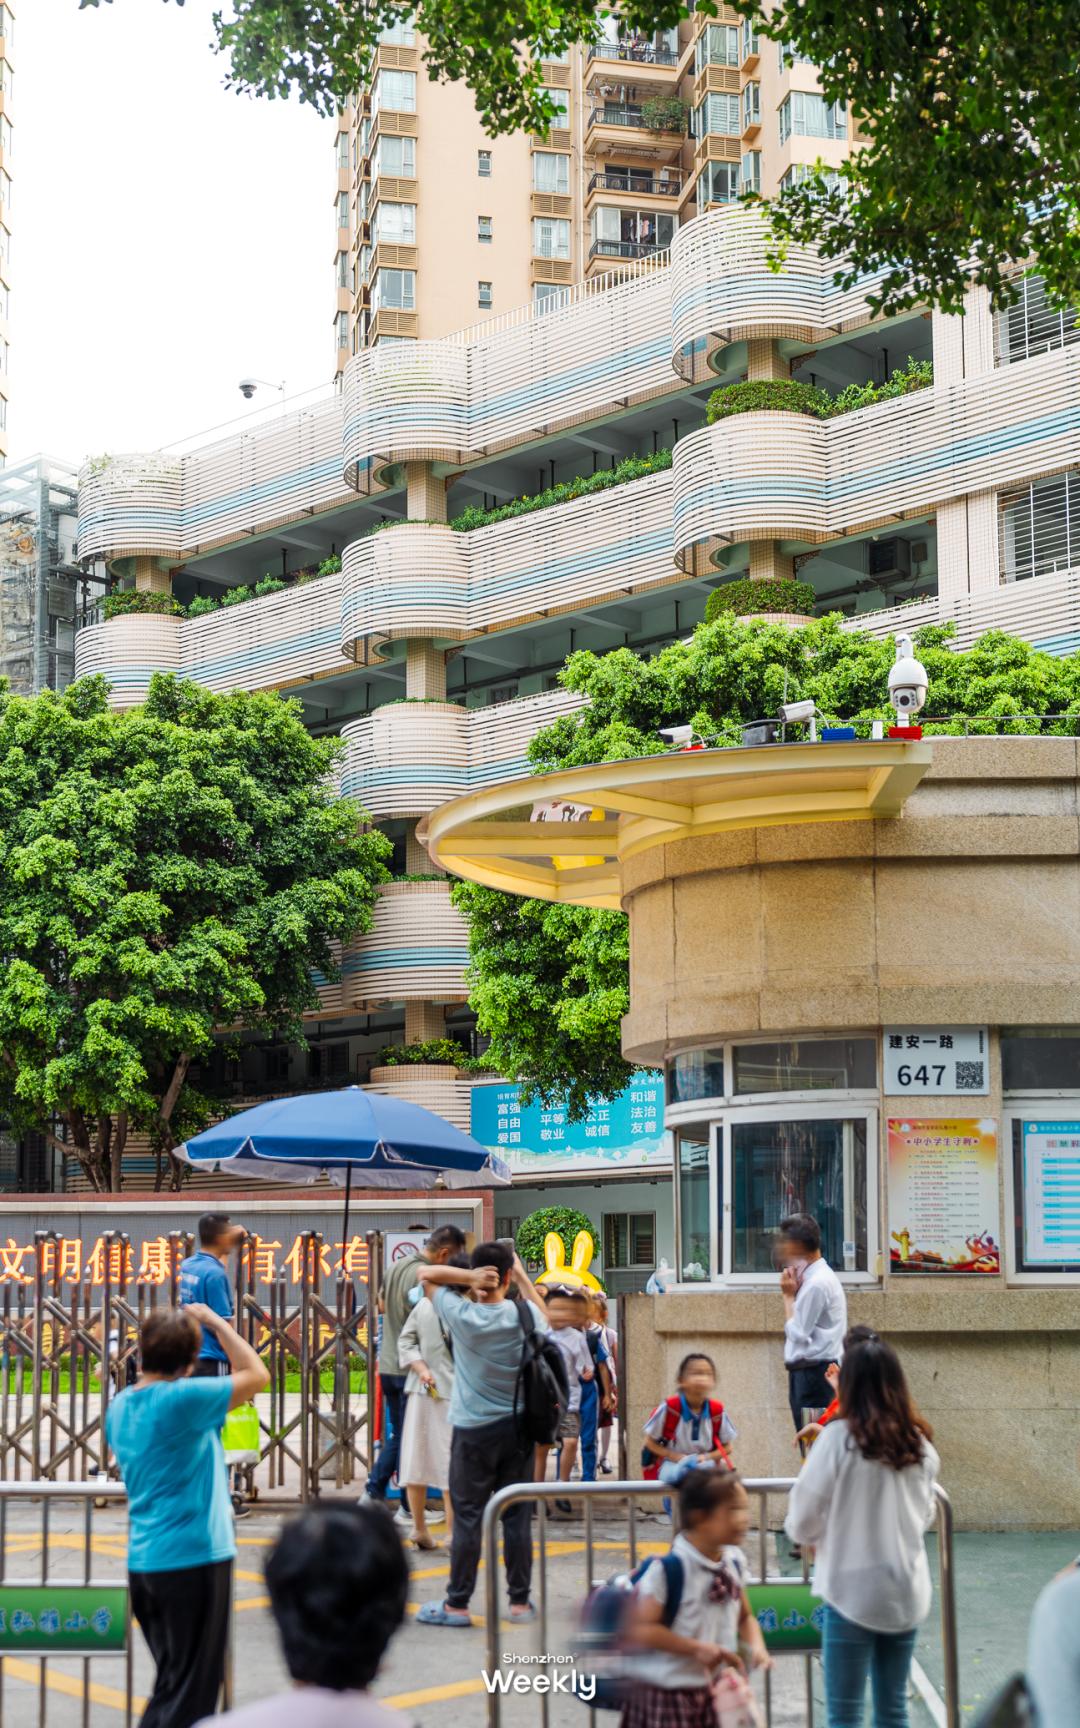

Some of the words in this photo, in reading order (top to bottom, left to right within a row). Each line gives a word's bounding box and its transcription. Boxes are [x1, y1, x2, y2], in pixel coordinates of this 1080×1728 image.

[889, 1034, 954, 1049] 建安一路
[897, 1065, 946, 1086] 647
[498, 1103, 520, 1115] 富强
[631, 1090, 657, 1103] 和谐
[498, 1117, 520, 1129] 自由
[541, 1113, 565, 1126] 平等
[586, 1109, 610, 1122] 公正
[631, 1106, 657, 1119] 法治
[498, 1131, 520, 1144] 爱国
[540, 1128, 565, 1140] 敬业
[585, 1124, 610, 1137] 诚信
[631, 1121, 657, 1134] 友善
[913, 1136, 972, 1146] 中小学生守则
